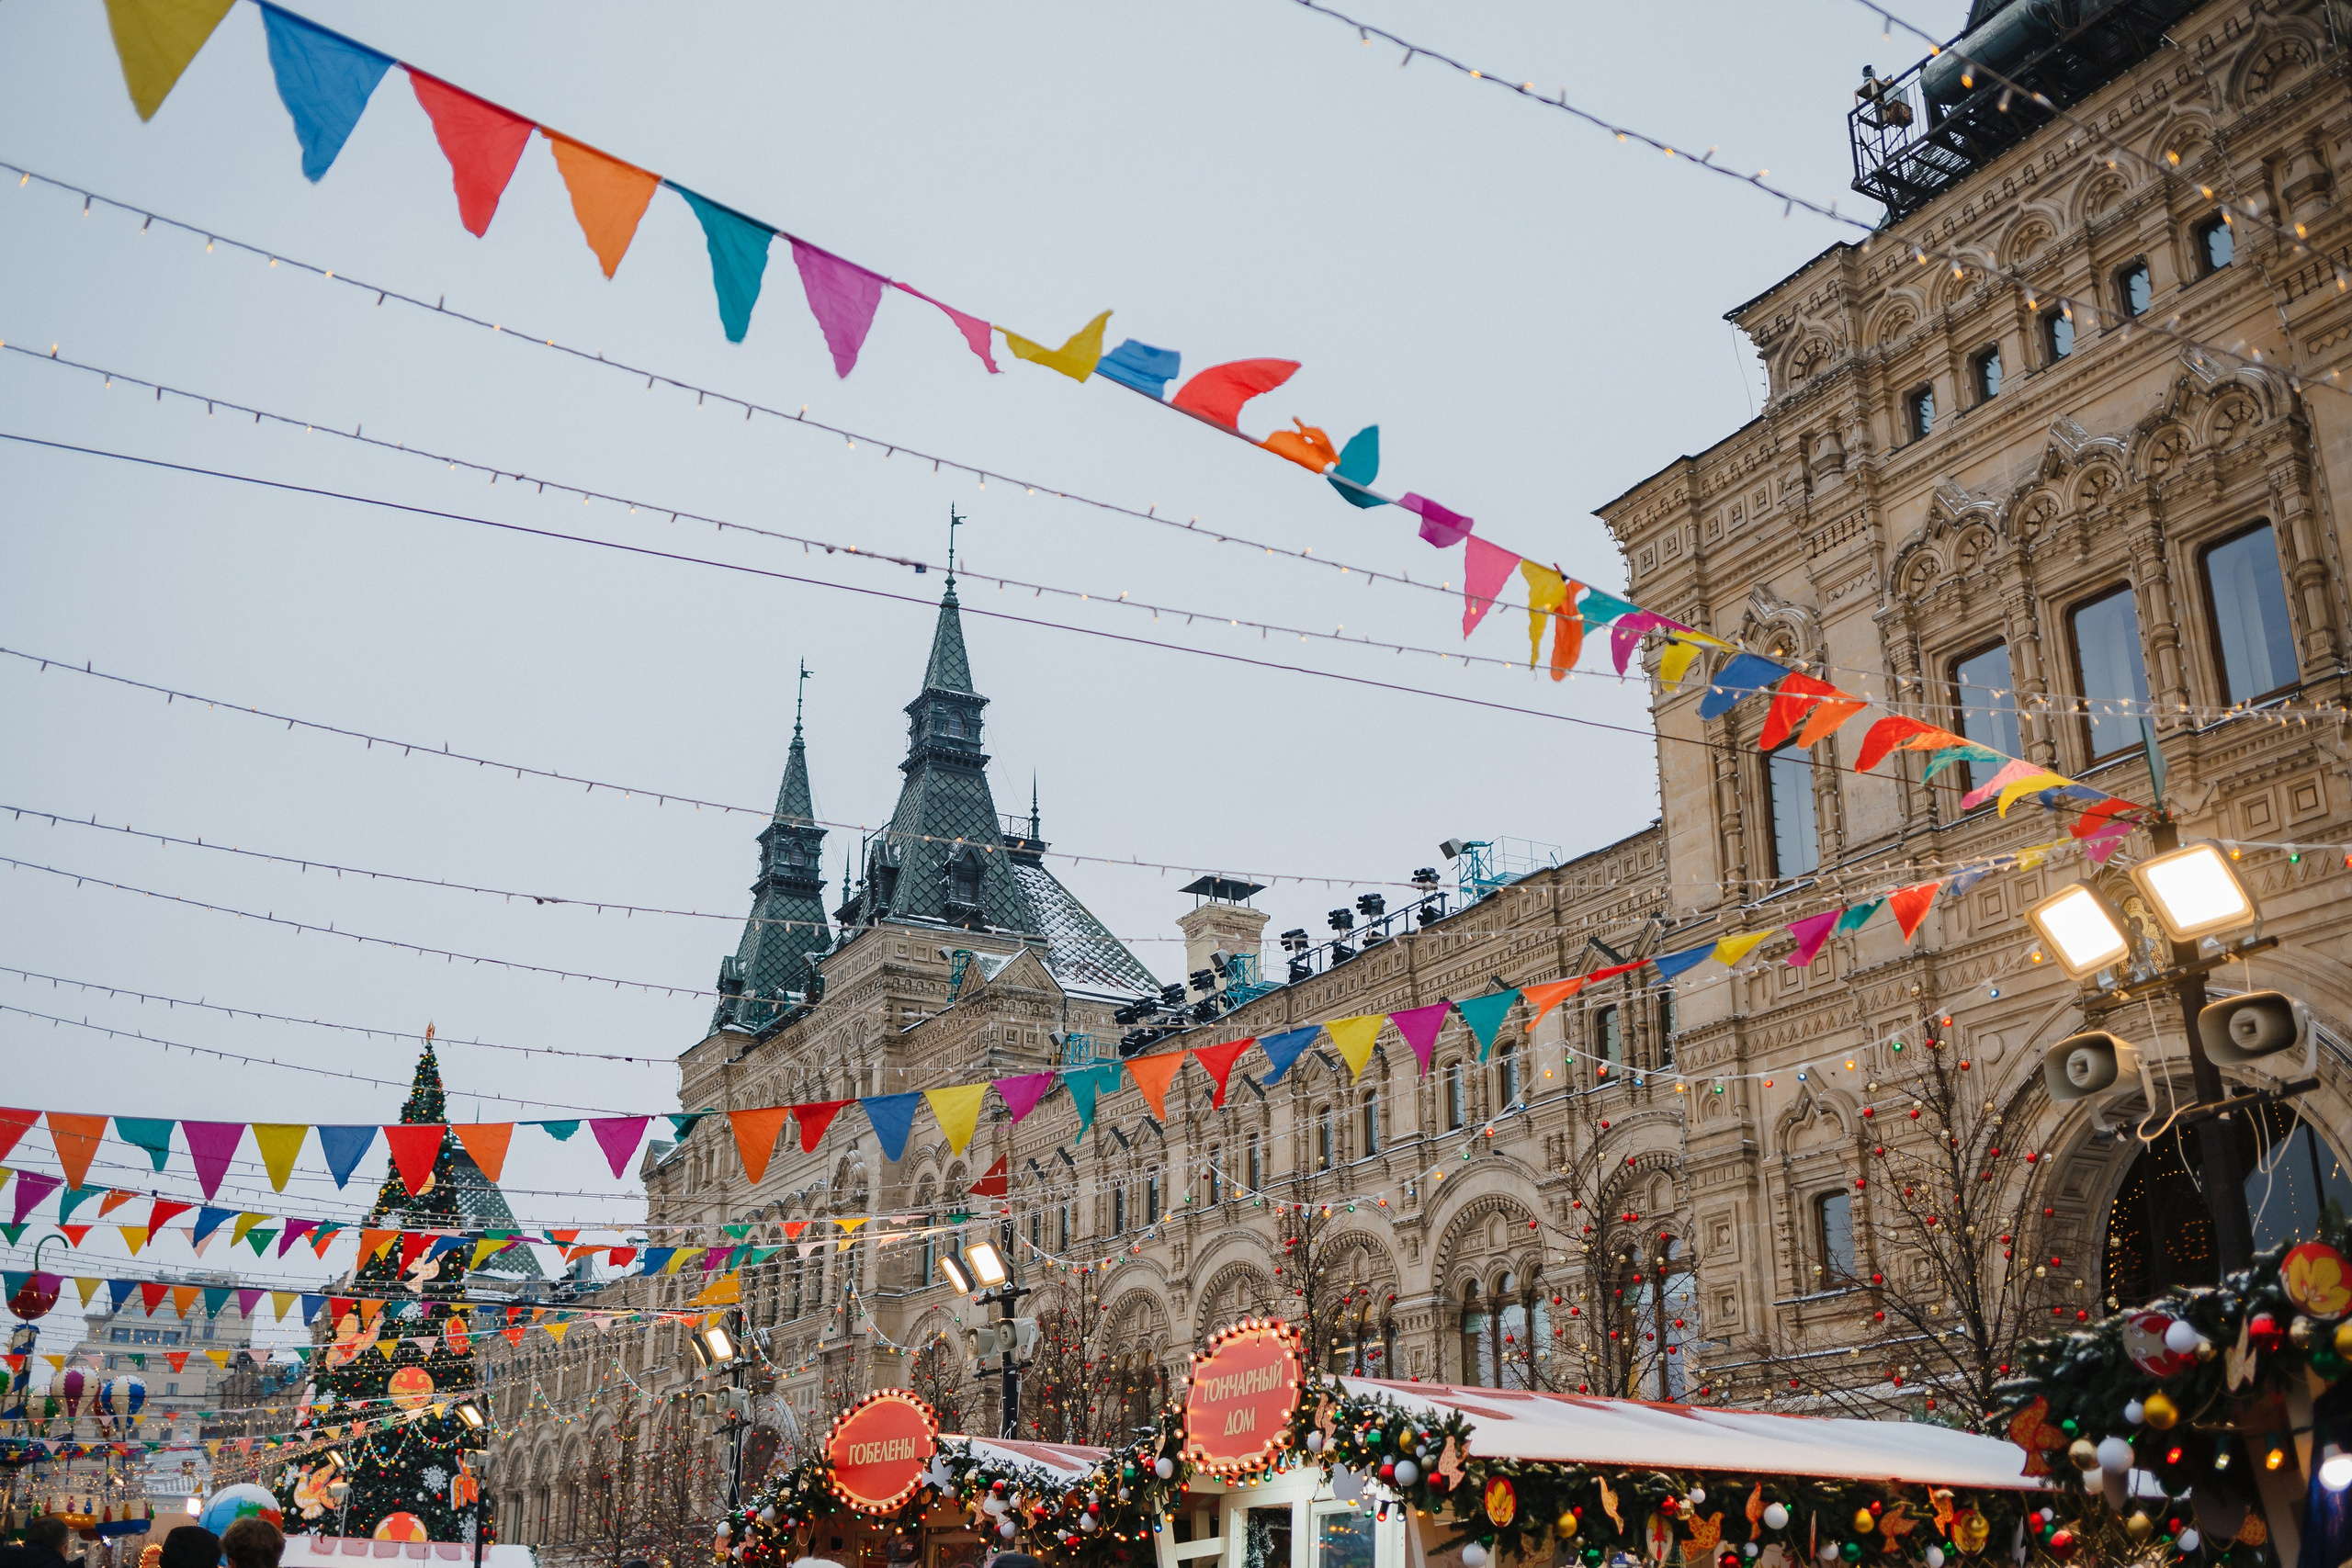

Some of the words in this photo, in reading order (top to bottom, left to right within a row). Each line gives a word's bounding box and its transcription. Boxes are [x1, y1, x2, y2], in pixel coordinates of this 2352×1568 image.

[1204, 1358, 1283, 1403] ГОНЧАРНЫЙ
[1224, 1406, 1255, 1437] ДОМ
[848, 1437, 916, 1465] ГОБЕЛЕНЫ
